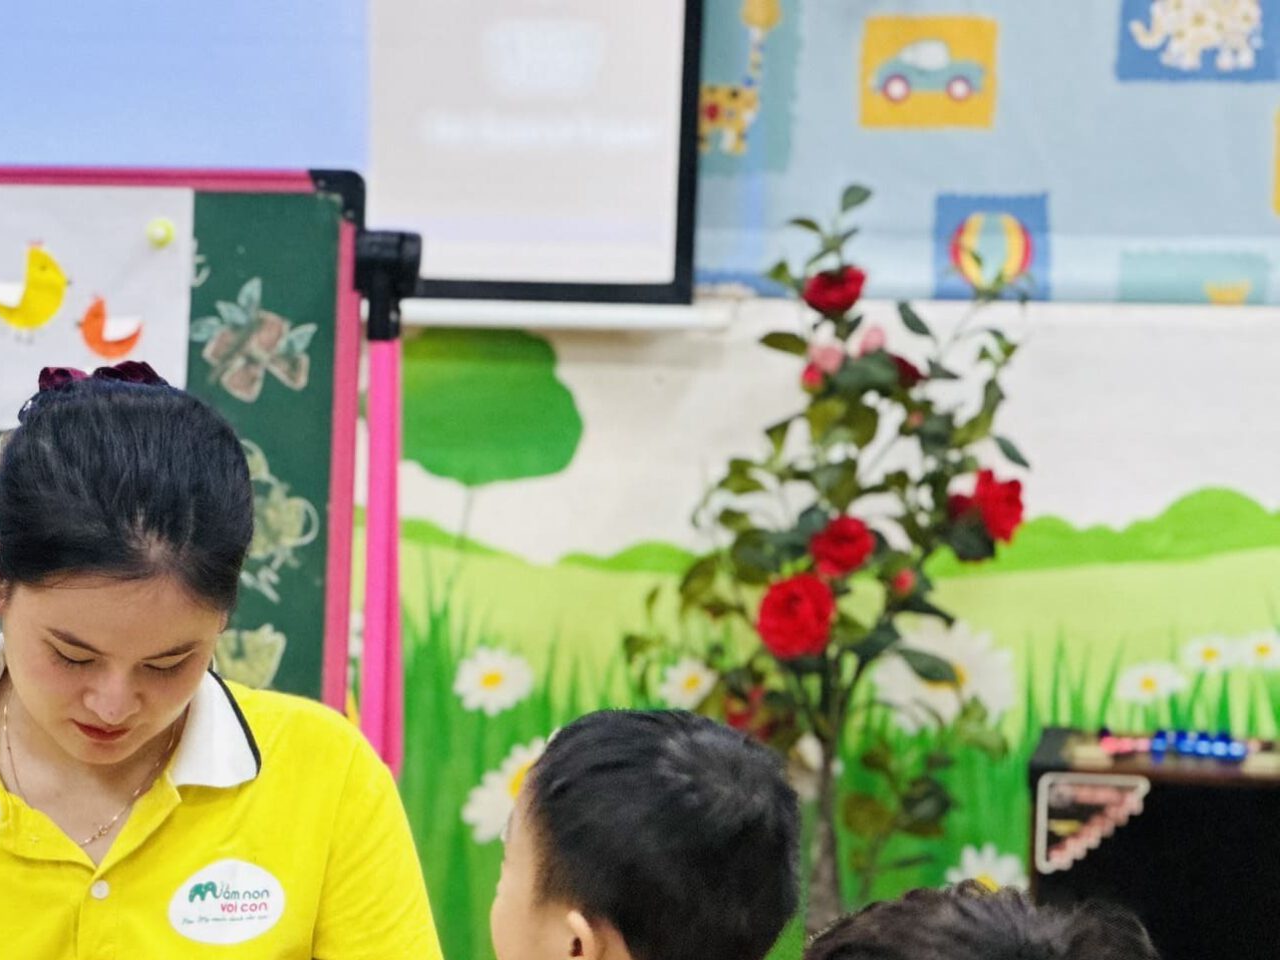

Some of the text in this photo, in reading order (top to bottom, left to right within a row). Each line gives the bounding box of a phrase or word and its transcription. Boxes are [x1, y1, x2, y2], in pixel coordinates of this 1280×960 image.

[242, 888, 270, 900] non
[220, 901, 268, 913] voi con
